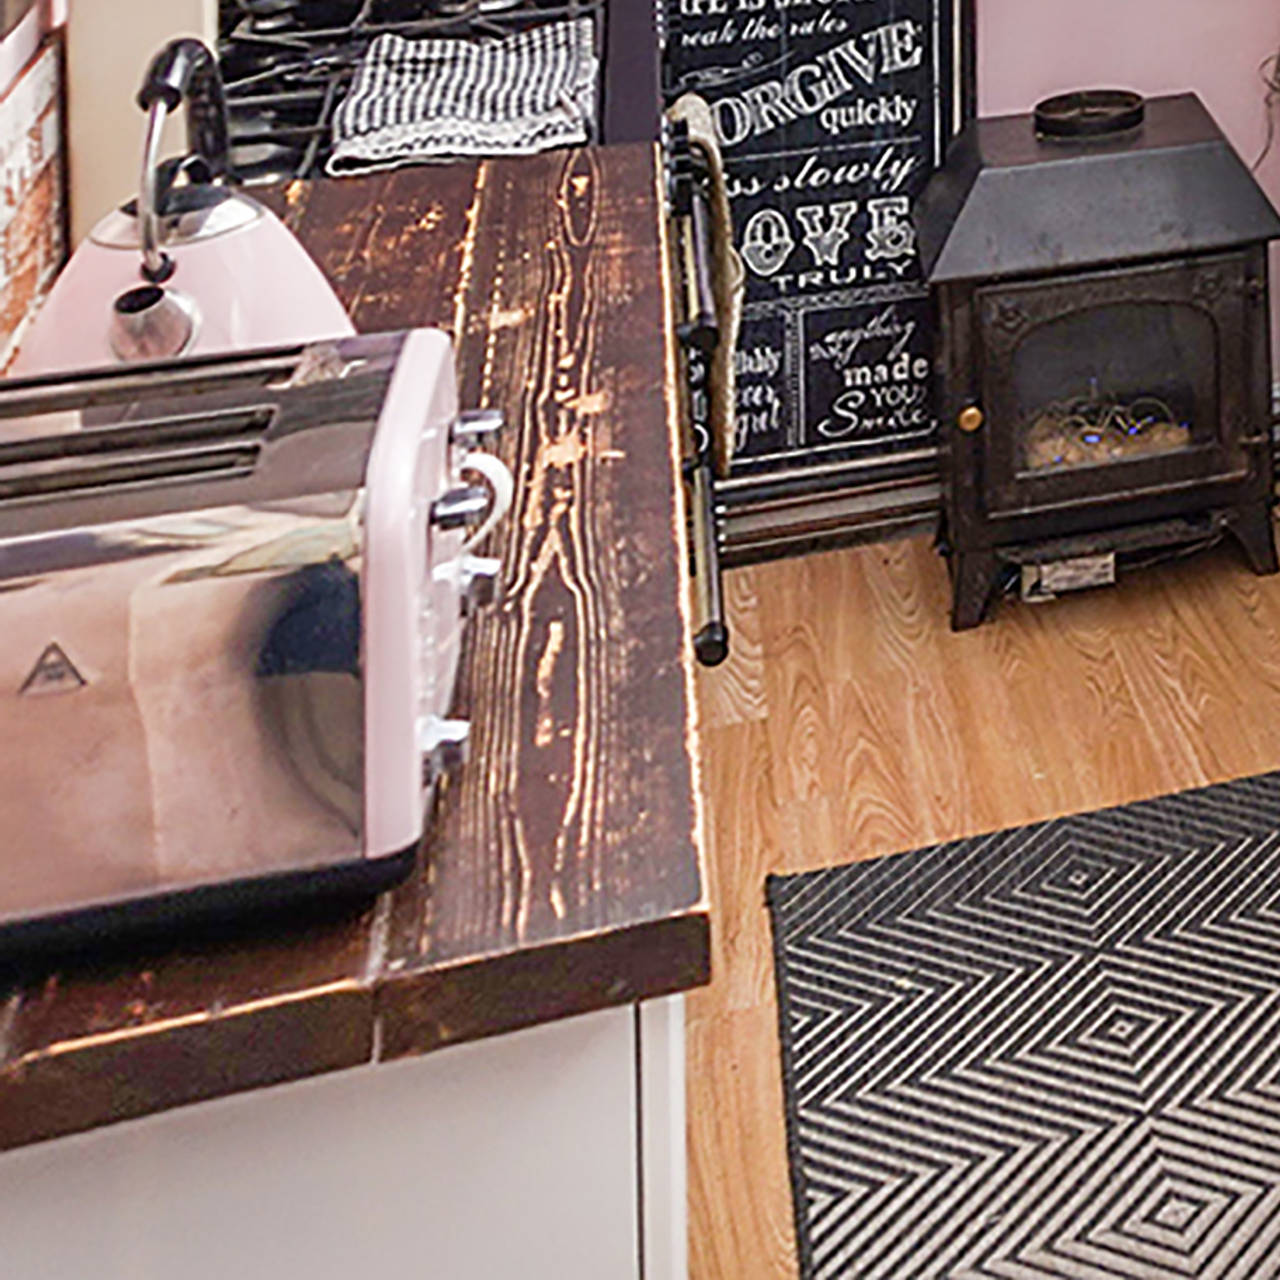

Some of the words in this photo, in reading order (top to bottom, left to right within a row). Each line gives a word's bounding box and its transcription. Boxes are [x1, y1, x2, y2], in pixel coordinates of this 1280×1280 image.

[710, 19, 924, 148] ORGIVE
[819, 94, 918, 136] quickly
[772, 146, 916, 193] slowly
[740, 195, 917, 277] OVE
[769, 258, 913, 292] TRULY
[843, 351, 930, 388] made
